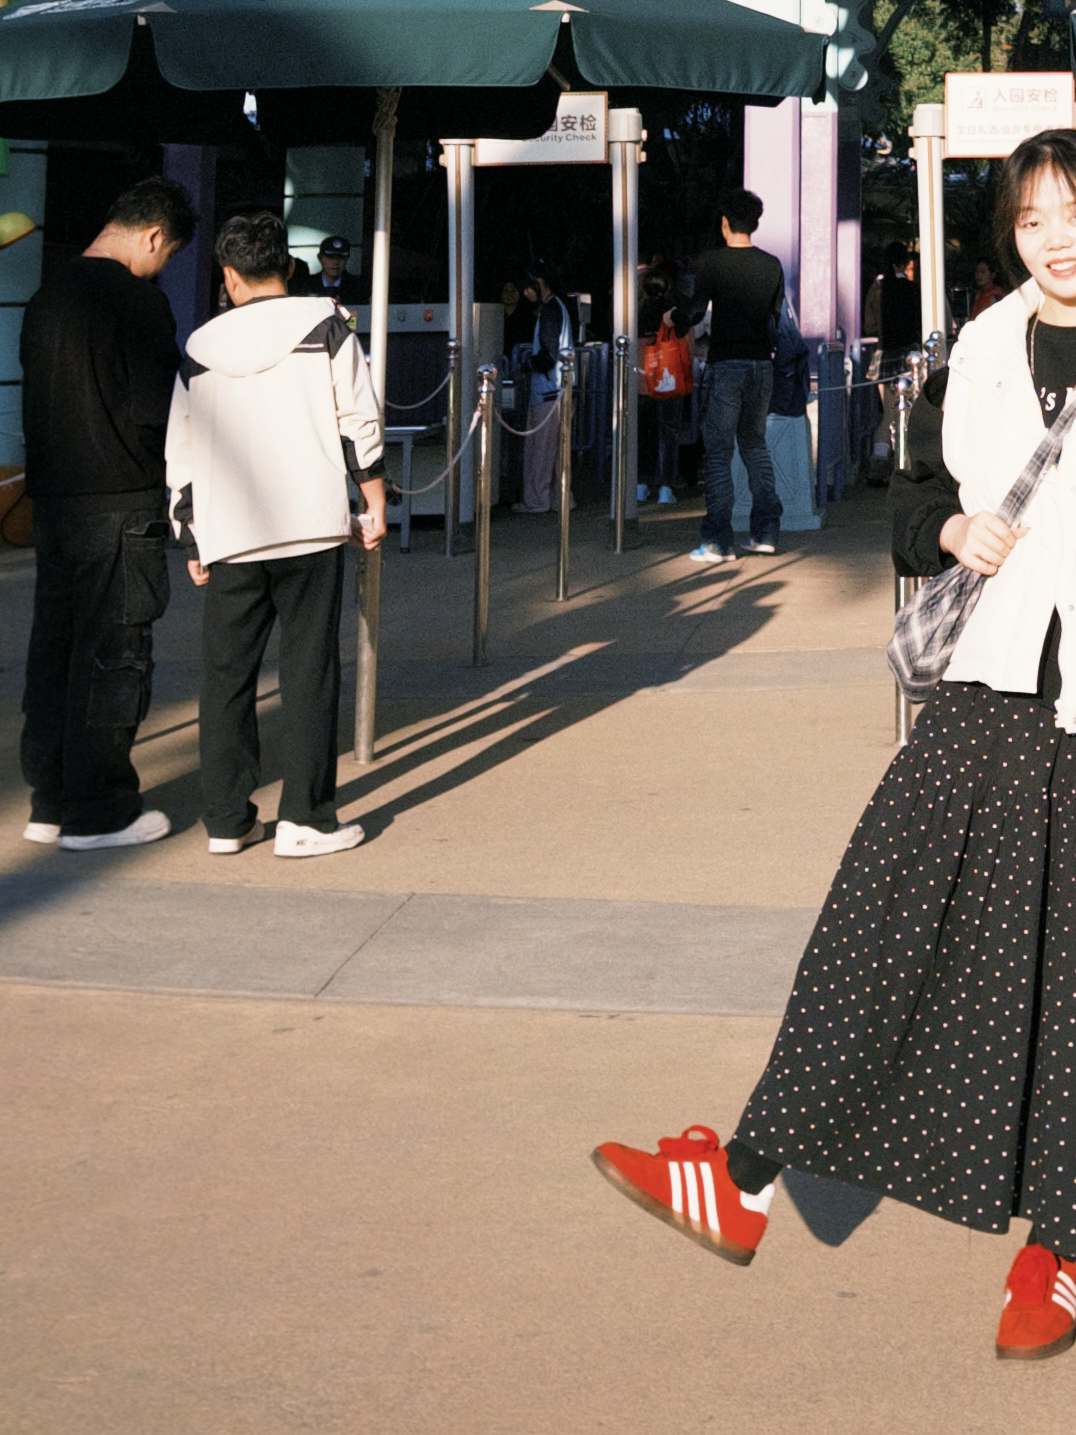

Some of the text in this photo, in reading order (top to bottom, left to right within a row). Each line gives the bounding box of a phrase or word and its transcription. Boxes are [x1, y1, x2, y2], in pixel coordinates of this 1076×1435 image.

[993, 88, 1058, 103] 入园安检
[565, 132, 598, 142] Check
